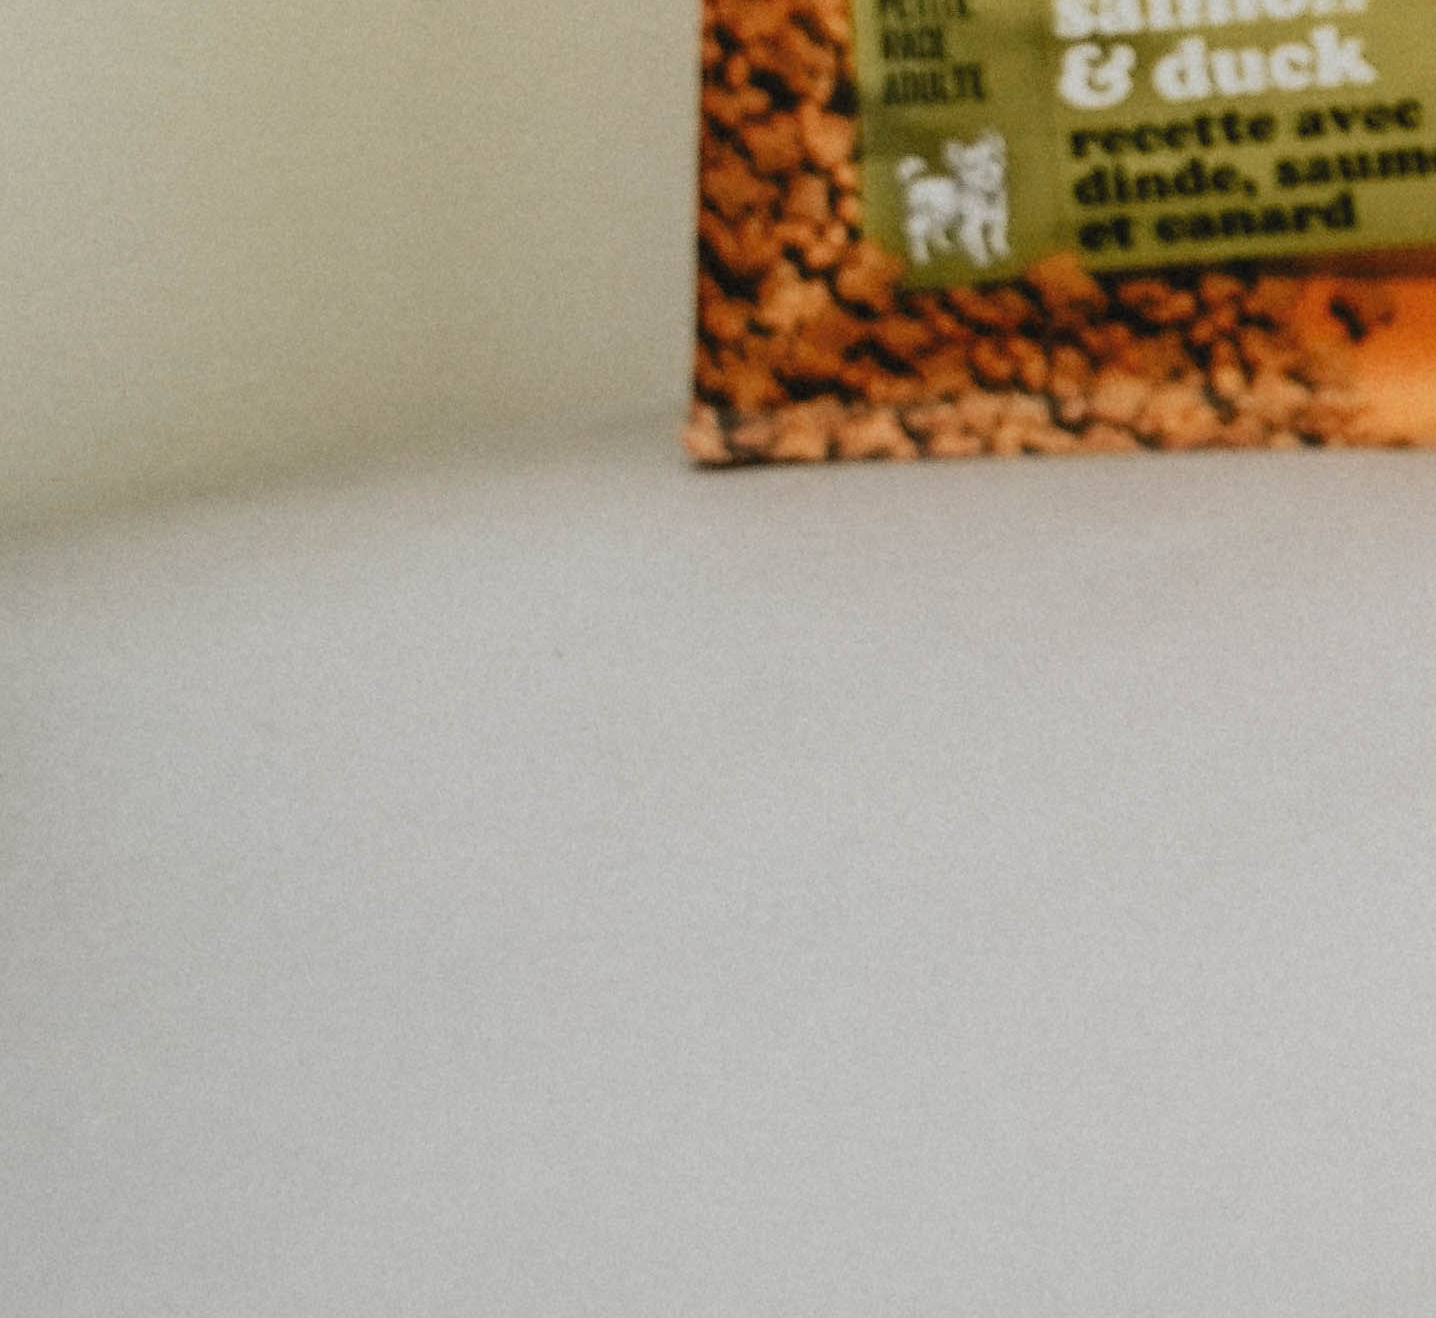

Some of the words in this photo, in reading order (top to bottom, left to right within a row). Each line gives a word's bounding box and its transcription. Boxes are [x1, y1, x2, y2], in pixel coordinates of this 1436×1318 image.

[1058, 40, 1137, 109] &
[1152, 23, 1378, 103] duck
[1071, 110, 1275, 160] recette
[1296, 98, 1422, 141] avec
[1073, 157, 1258, 207] dinde,
[1078, 213, 1134, 252] et
[1153, 188, 1357, 245] canard
